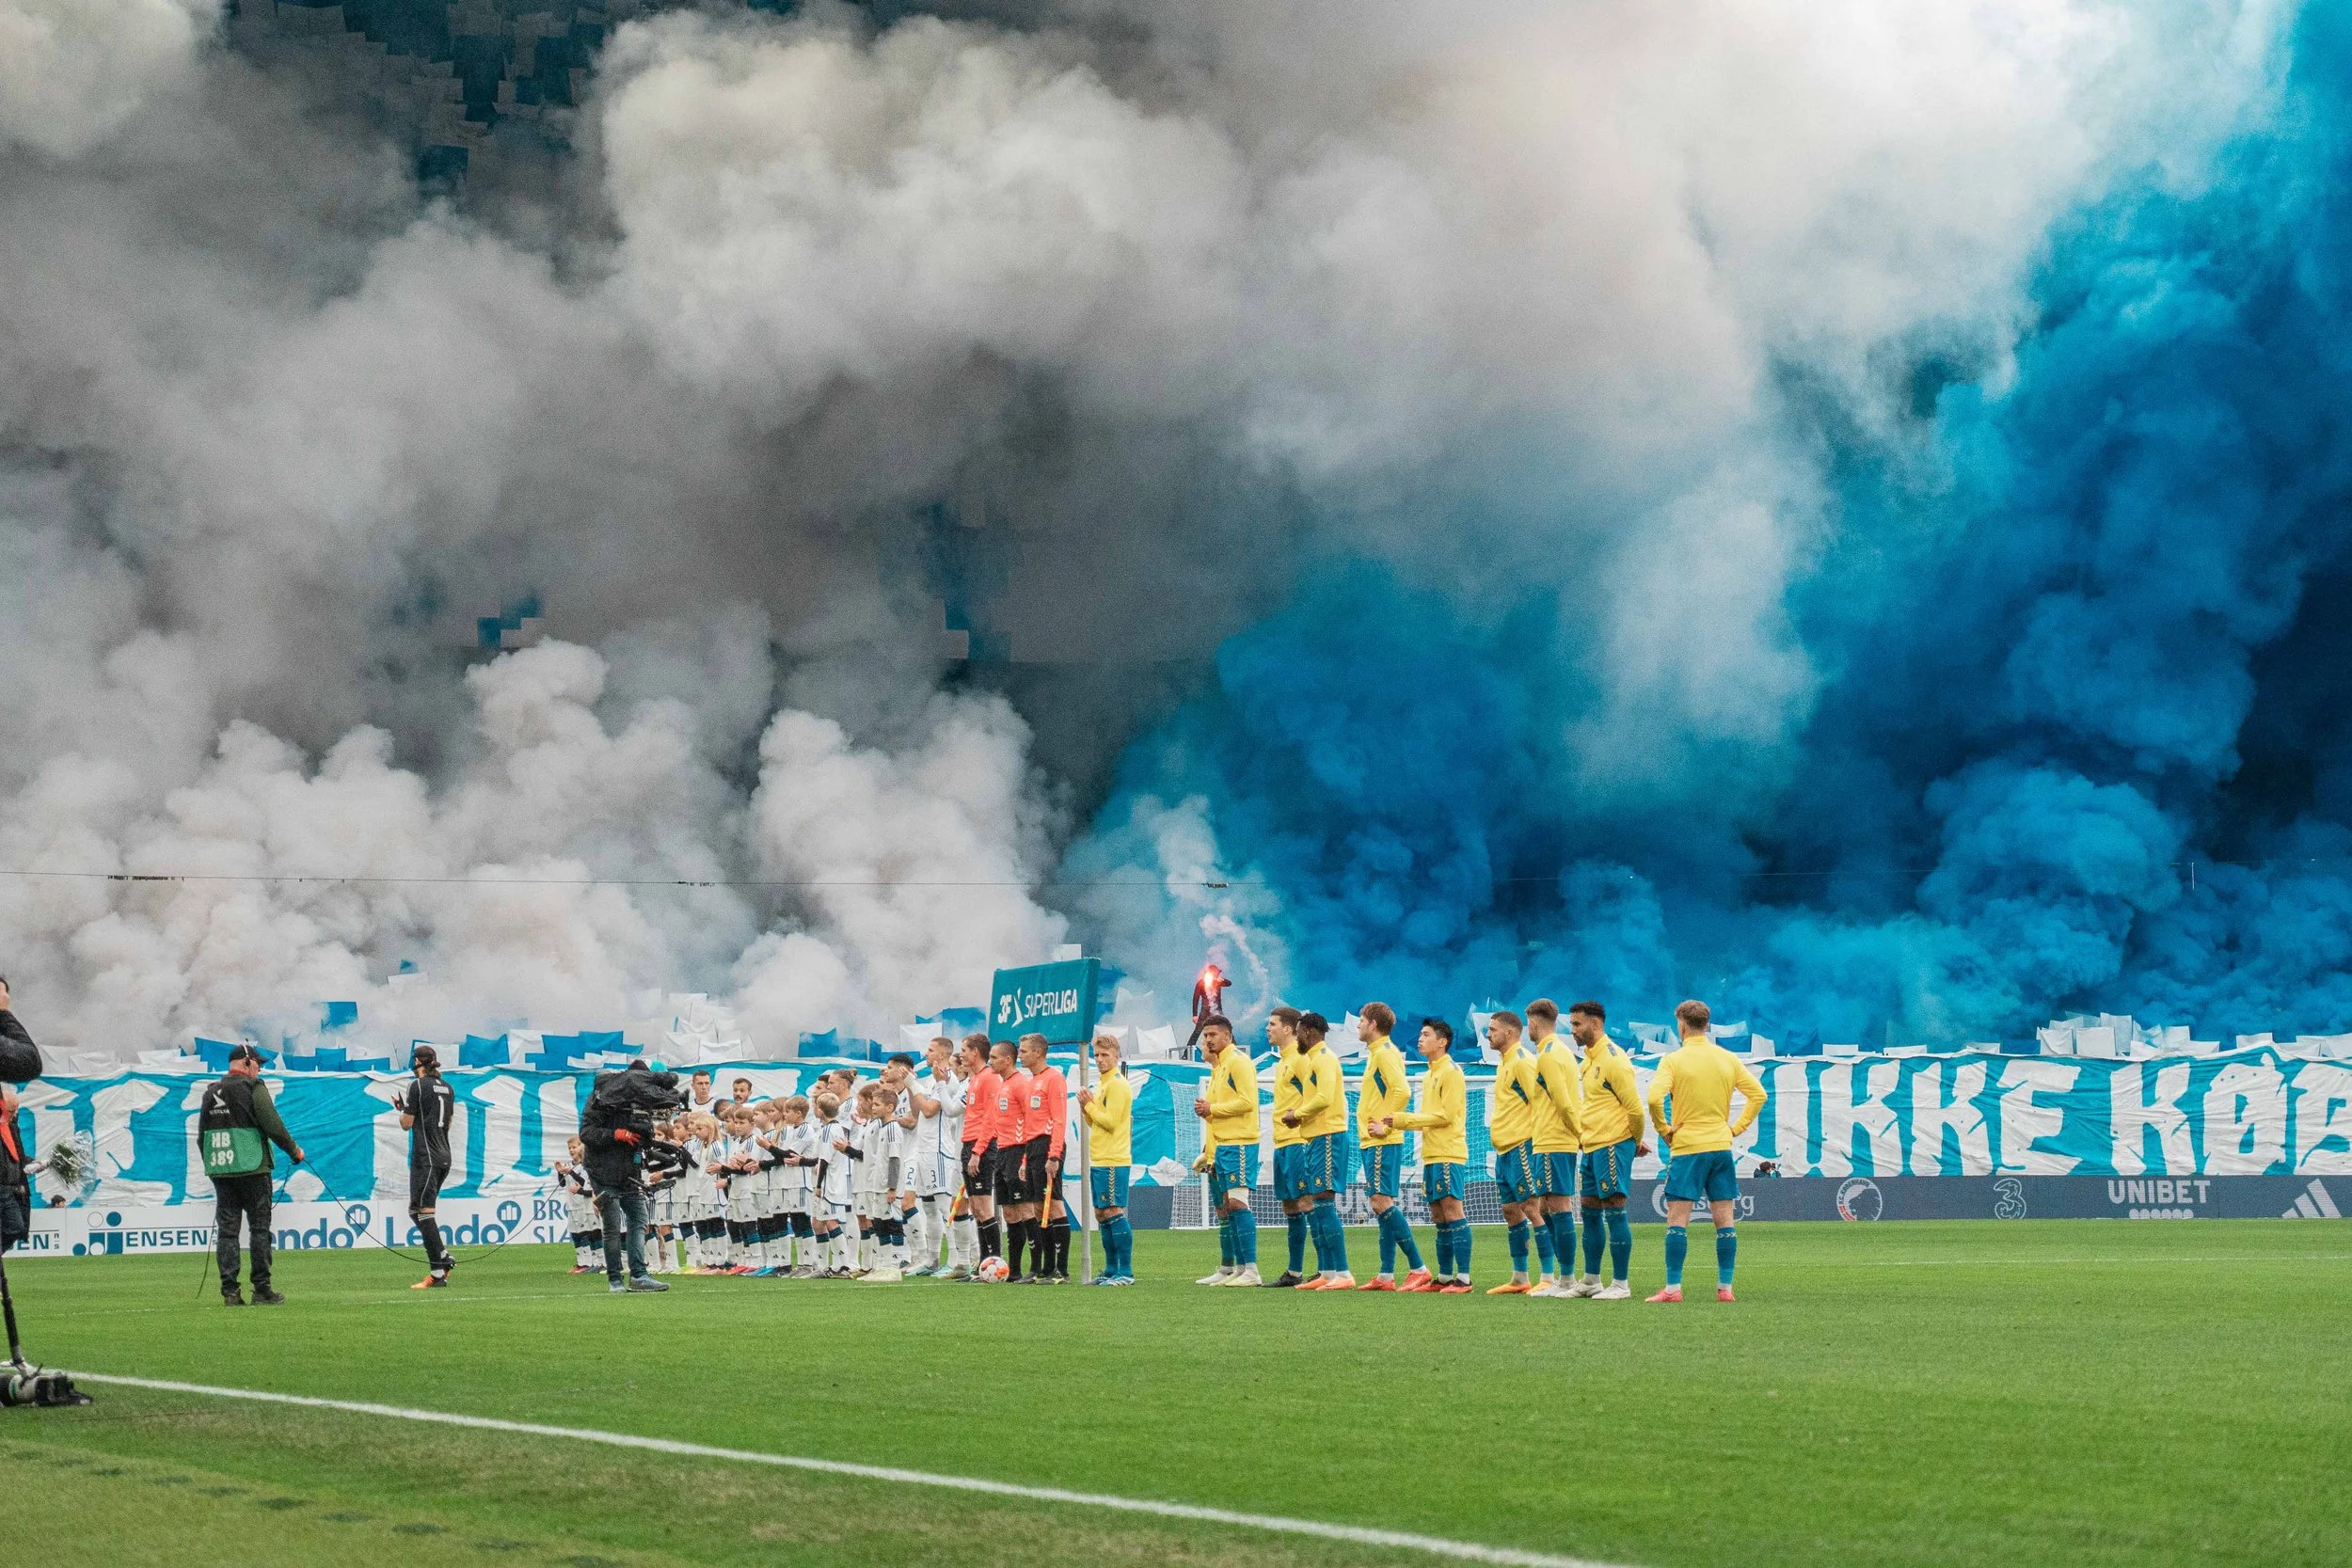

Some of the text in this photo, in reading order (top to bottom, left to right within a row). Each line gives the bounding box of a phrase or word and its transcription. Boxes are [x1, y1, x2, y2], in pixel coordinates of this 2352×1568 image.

[1024, 989, 1078, 1019] SUPERLIGA
[437, 1095, 445, 1128] 1
[2107, 1180, 2211, 1204] UNIBET
